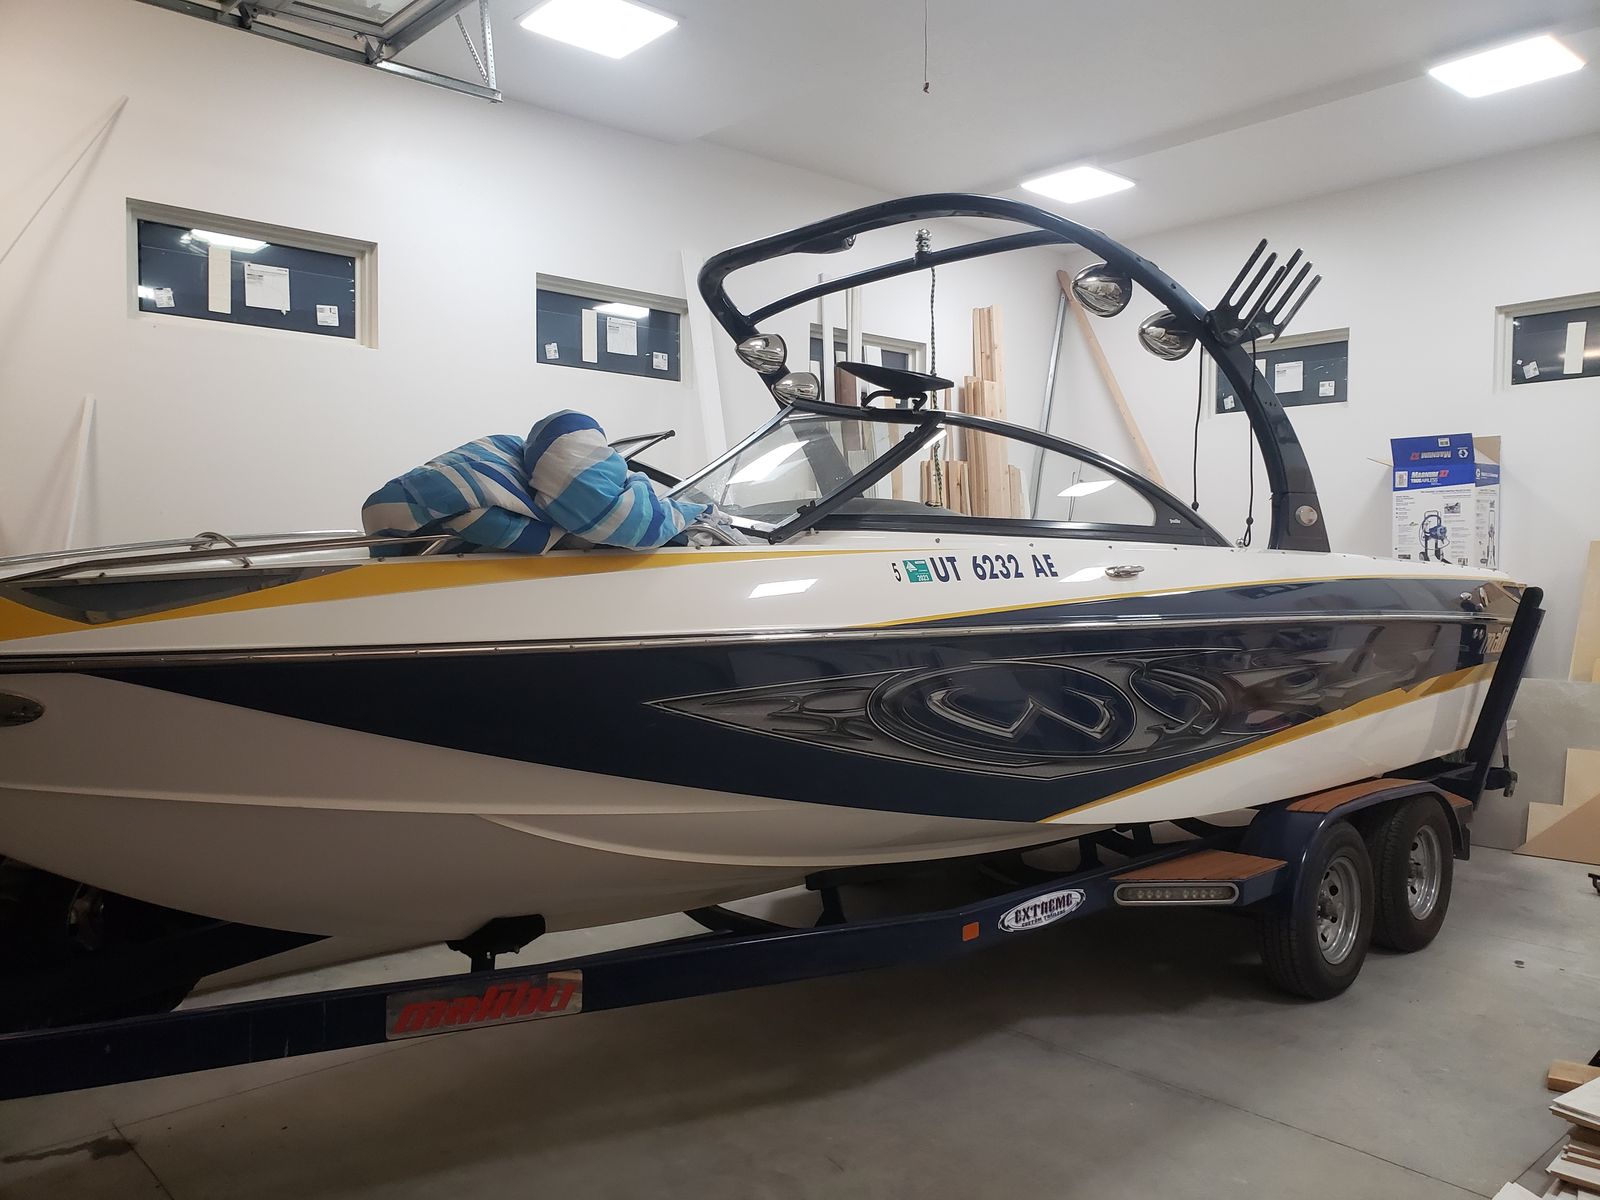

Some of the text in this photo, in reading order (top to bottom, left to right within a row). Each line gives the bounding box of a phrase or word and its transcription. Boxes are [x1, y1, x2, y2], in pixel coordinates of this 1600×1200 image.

[892, 553, 1059, 582] 5 UT 6232 AE
[1015, 893, 1073, 924] EXTREME
[1022, 918, 1042, 928] CUSTOM
[393, 982, 576, 1034] malibu
